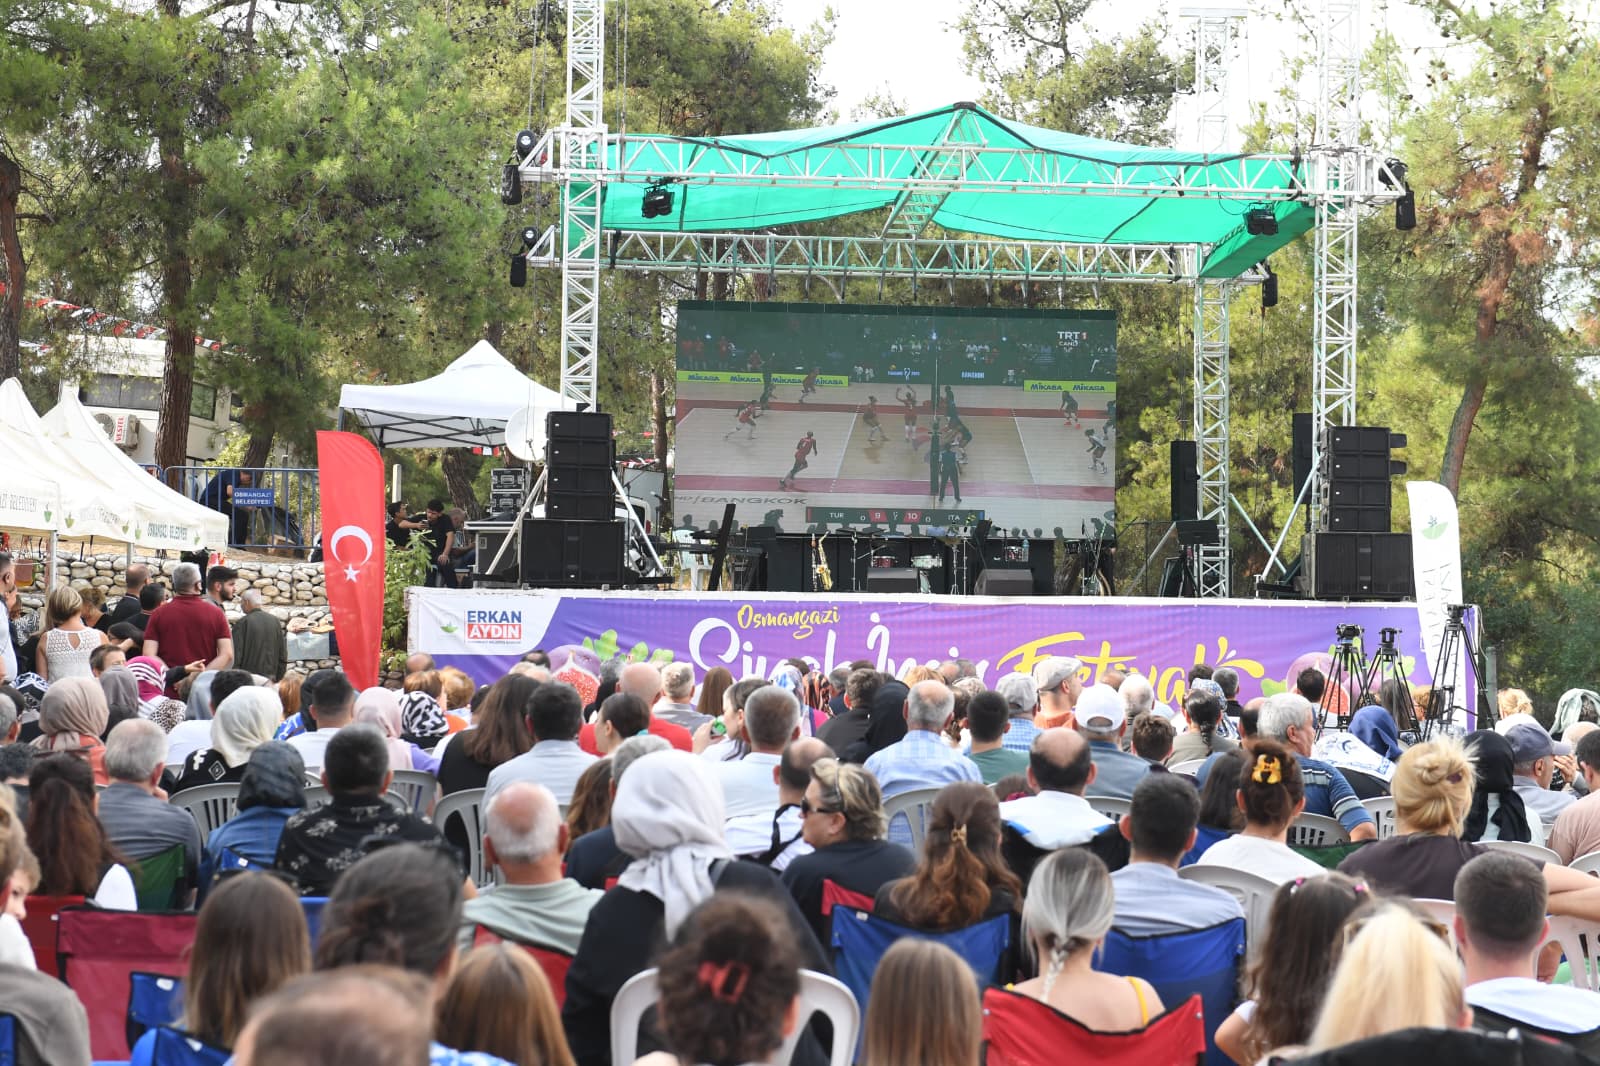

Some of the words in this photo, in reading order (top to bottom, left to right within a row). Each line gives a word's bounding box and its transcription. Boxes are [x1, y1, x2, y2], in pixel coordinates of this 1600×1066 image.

[1057, 331, 1080, 340] TRT
[1081, 332, 1088, 340] 1
[116, 416, 125, 442] VESTEL
[907, 512, 918, 520] 10
[467, 610, 522, 623] ERKAN
[737, 604, 841, 640] Osmangazi
[470, 625, 520, 639] AYDIN
